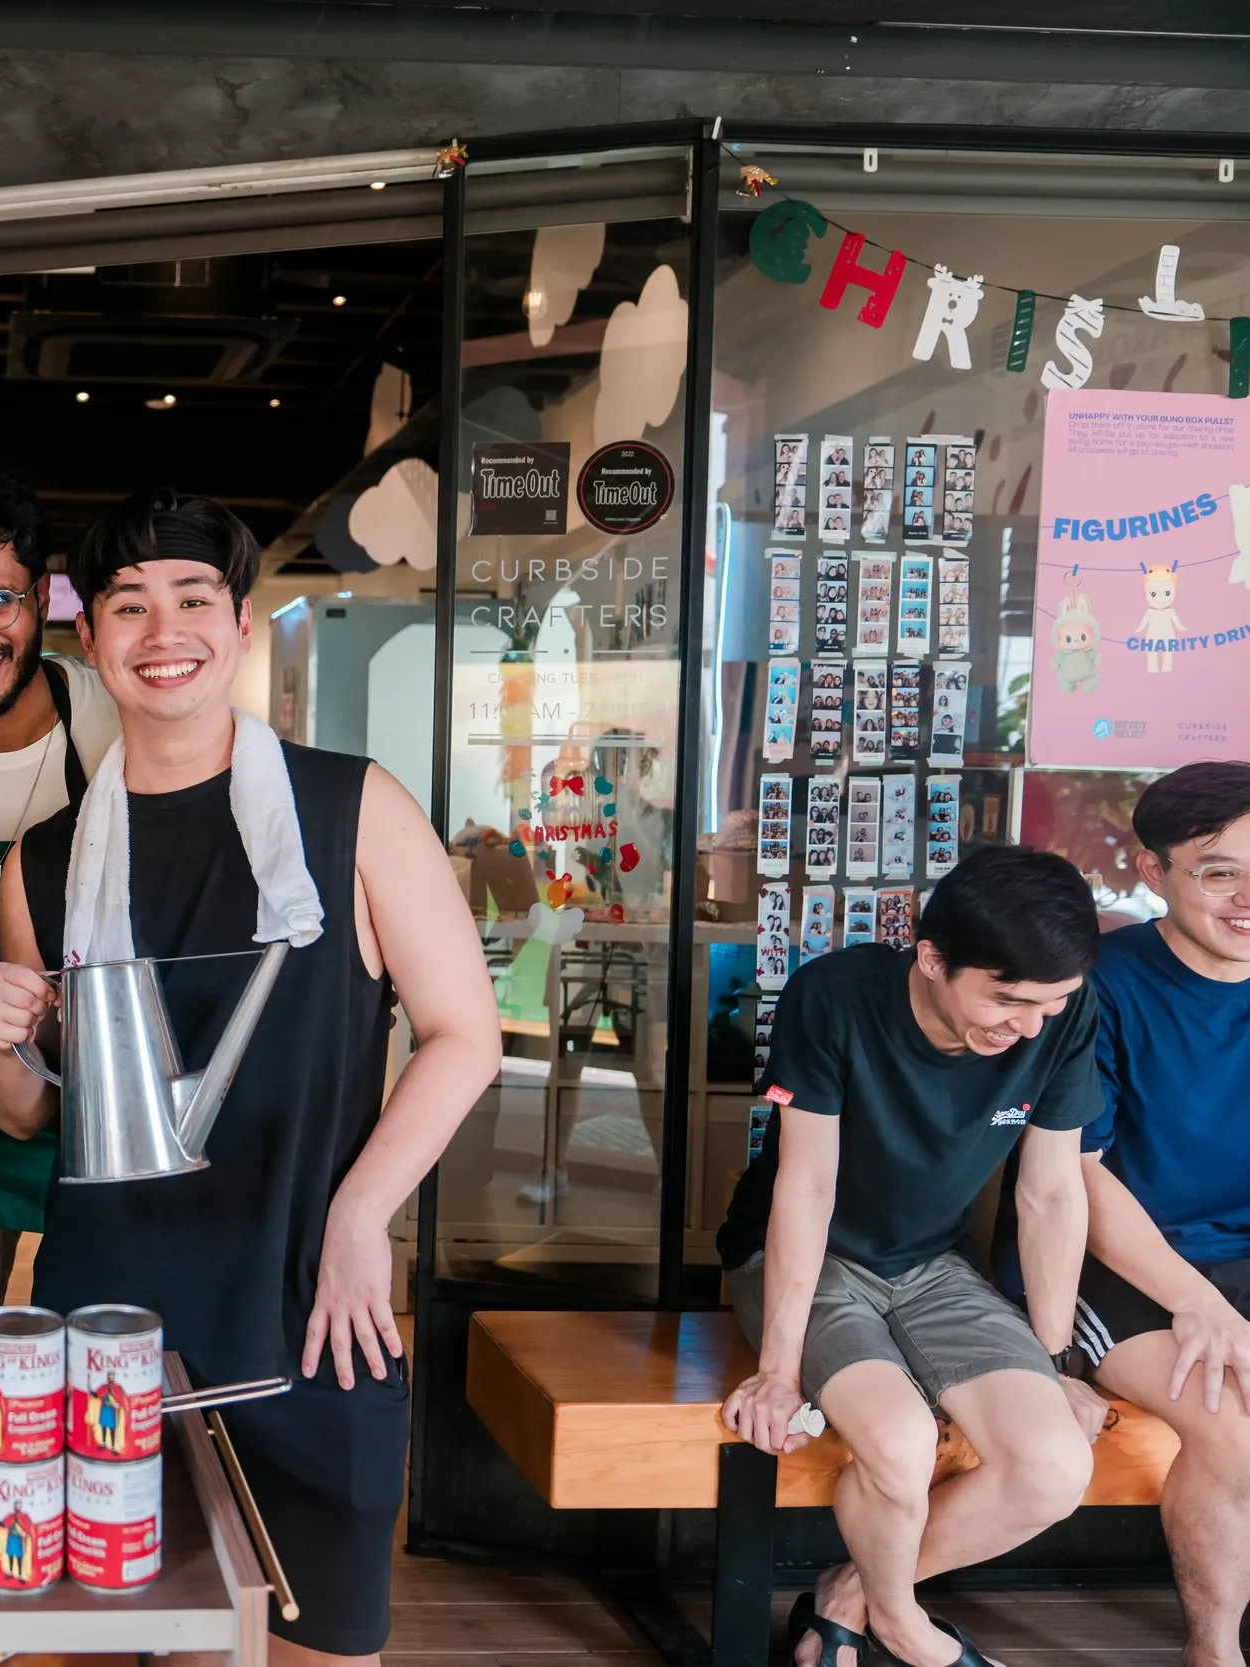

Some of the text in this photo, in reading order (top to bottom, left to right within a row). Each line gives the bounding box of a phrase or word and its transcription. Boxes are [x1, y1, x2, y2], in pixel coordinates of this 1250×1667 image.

[1069, 412, 1234, 425] UNHAPPY WITH YOUR BLIND BOX PULLS?
[1187, 424, 1214, 434] charity
[480, 456, 535, 465] Recommended by
[601, 467, 653, 476] Recommended by
[1052, 493, 1218, 542] FIGURINES
[471, 556, 669, 582] CURBSIDE
[470, 604, 667, 629] CRAFTERS
[1126, 635, 1209, 653] CHARITY
[1178, 721, 1227, 731] CURBSIDE
[1178, 733, 1227, 742] CRAFTERS
[521, 820, 619, 843] CHRISTMAS
[18, 1348, 61, 1371] KINGS
[86, 1346, 129, 1372] KING
